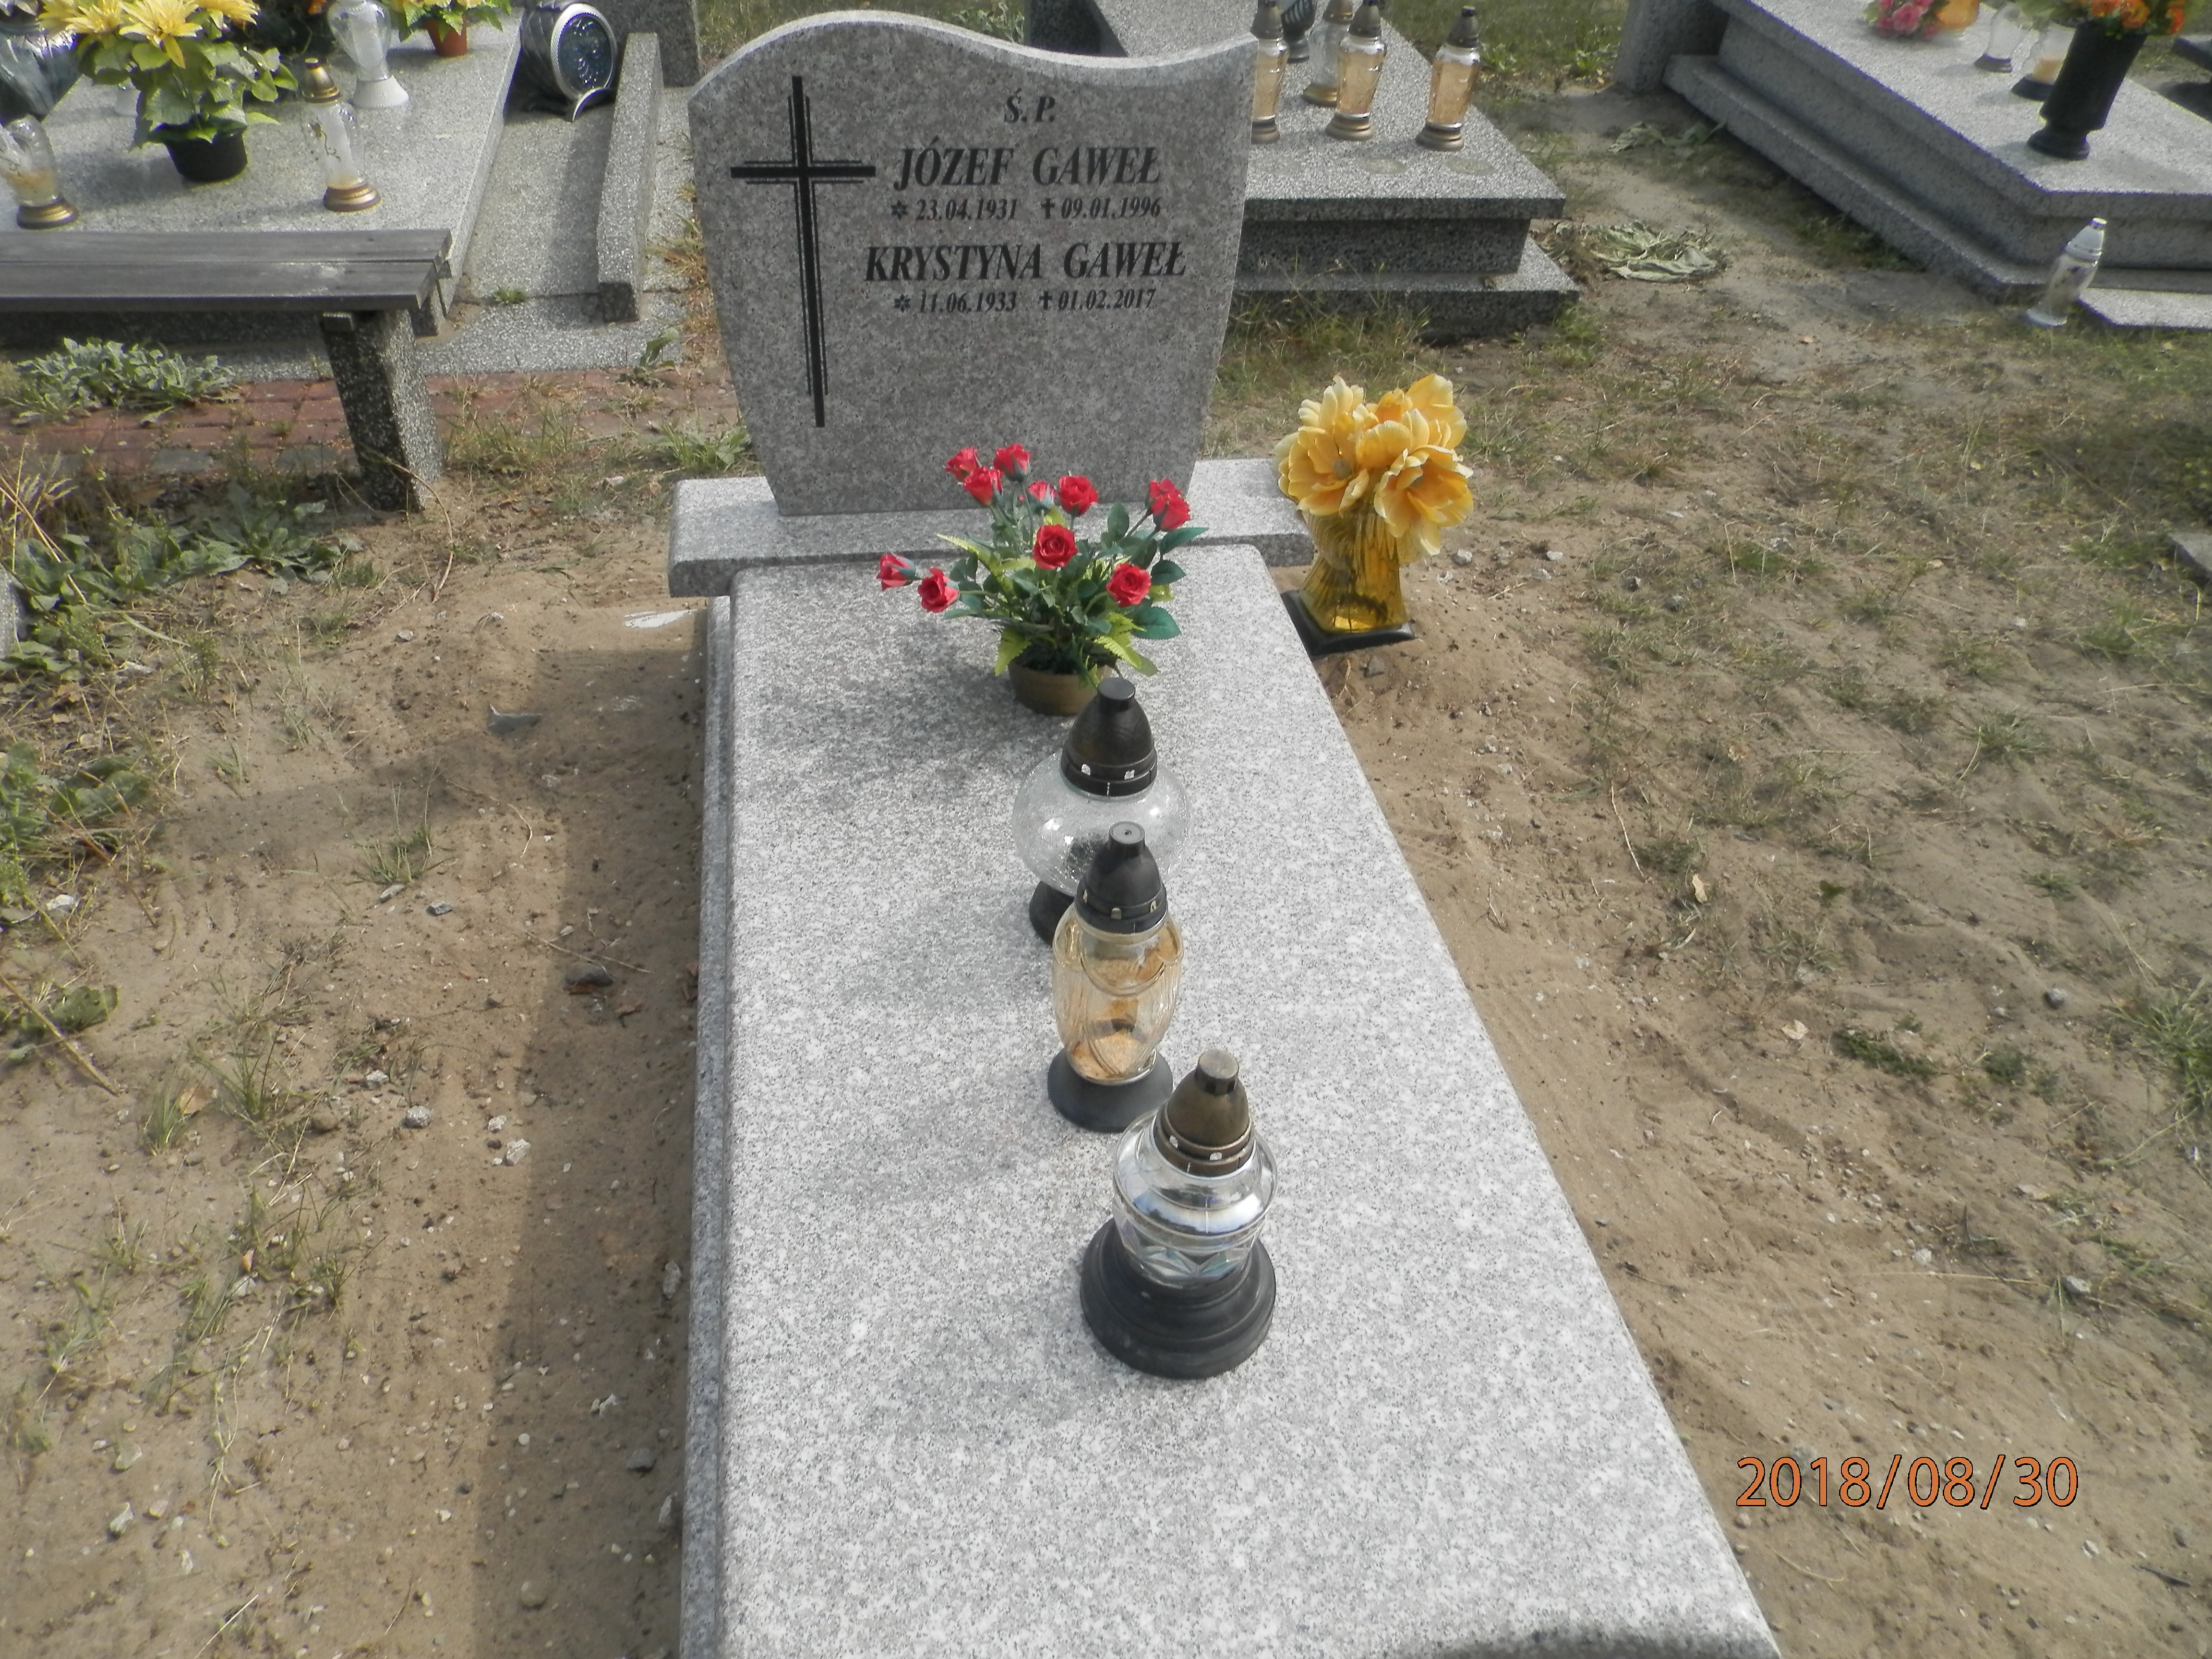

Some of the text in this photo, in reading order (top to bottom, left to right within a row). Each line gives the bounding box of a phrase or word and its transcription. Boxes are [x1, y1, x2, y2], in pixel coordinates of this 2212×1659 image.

[893, 135, 1161, 191] JÓZEF GAWEŁ
[915, 197, 1161, 221] 23.04.1931 09.01.1996
[865, 242, 1187, 281] KRYSTYNA GAWEŁ
[918, 289, 1156, 313] 11.06.1933 01.02.2017
